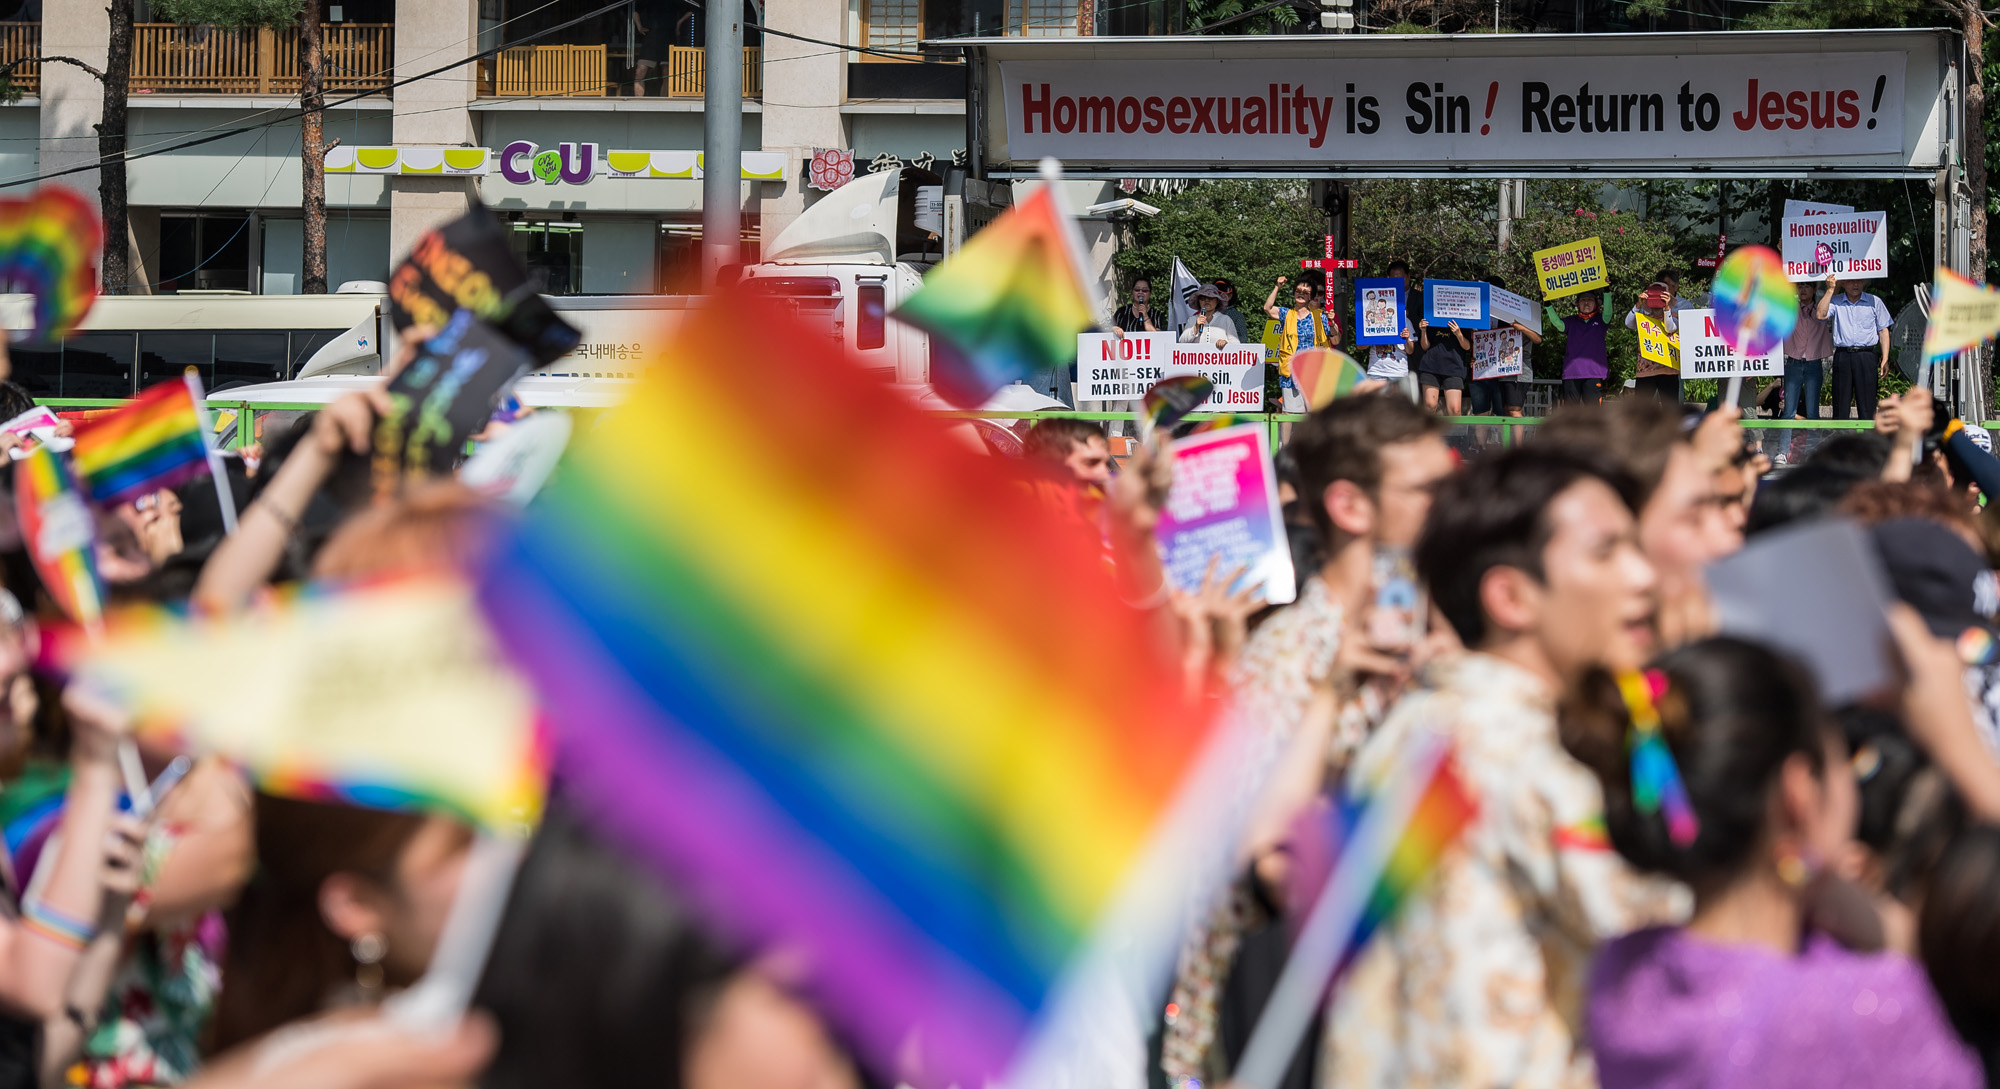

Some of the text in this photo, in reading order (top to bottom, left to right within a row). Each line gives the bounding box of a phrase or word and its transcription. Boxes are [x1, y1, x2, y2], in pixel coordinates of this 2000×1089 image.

[1022, 82, 1334, 149] Homosexuality
[1345, 82, 1380, 135] is
[1522, 80, 1664, 133] Return
[1677, 80, 1720, 132] to
[1733, 74, 1887, 132] Jesus!
[1789, 218, 1878, 238] Homosexuality
[1831, 239, 1852, 254] sin,
[1541, 245, 1596, 272] 동성애의 죄악!
[1697, 258, 1716, 267] Believe
[1788, 260, 1828, 275] Return
[1832, 260, 1844, 272] to
[1848, 258, 1882, 272] Jesus
[1545, 265, 1600, 291] 하나님의 심판!
[1640, 321, 1661, 337] 예수
[576, 343, 643, 360] 국내배송은
[1101, 338, 1151, 361] NO!!
[1643, 338, 1664, 357] 불신
[1172, 350, 1258, 367] Homosexuality
[1694, 359, 1770, 373] MARRIAGE
[1092, 366, 1161, 380] SAME-SEX
[1212, 370, 1232, 385] sin,
[1091, 382, 1154, 396] MARRIAG
[1212, 391, 1223, 404] to
[1227, 389, 1260, 404] Jesus
